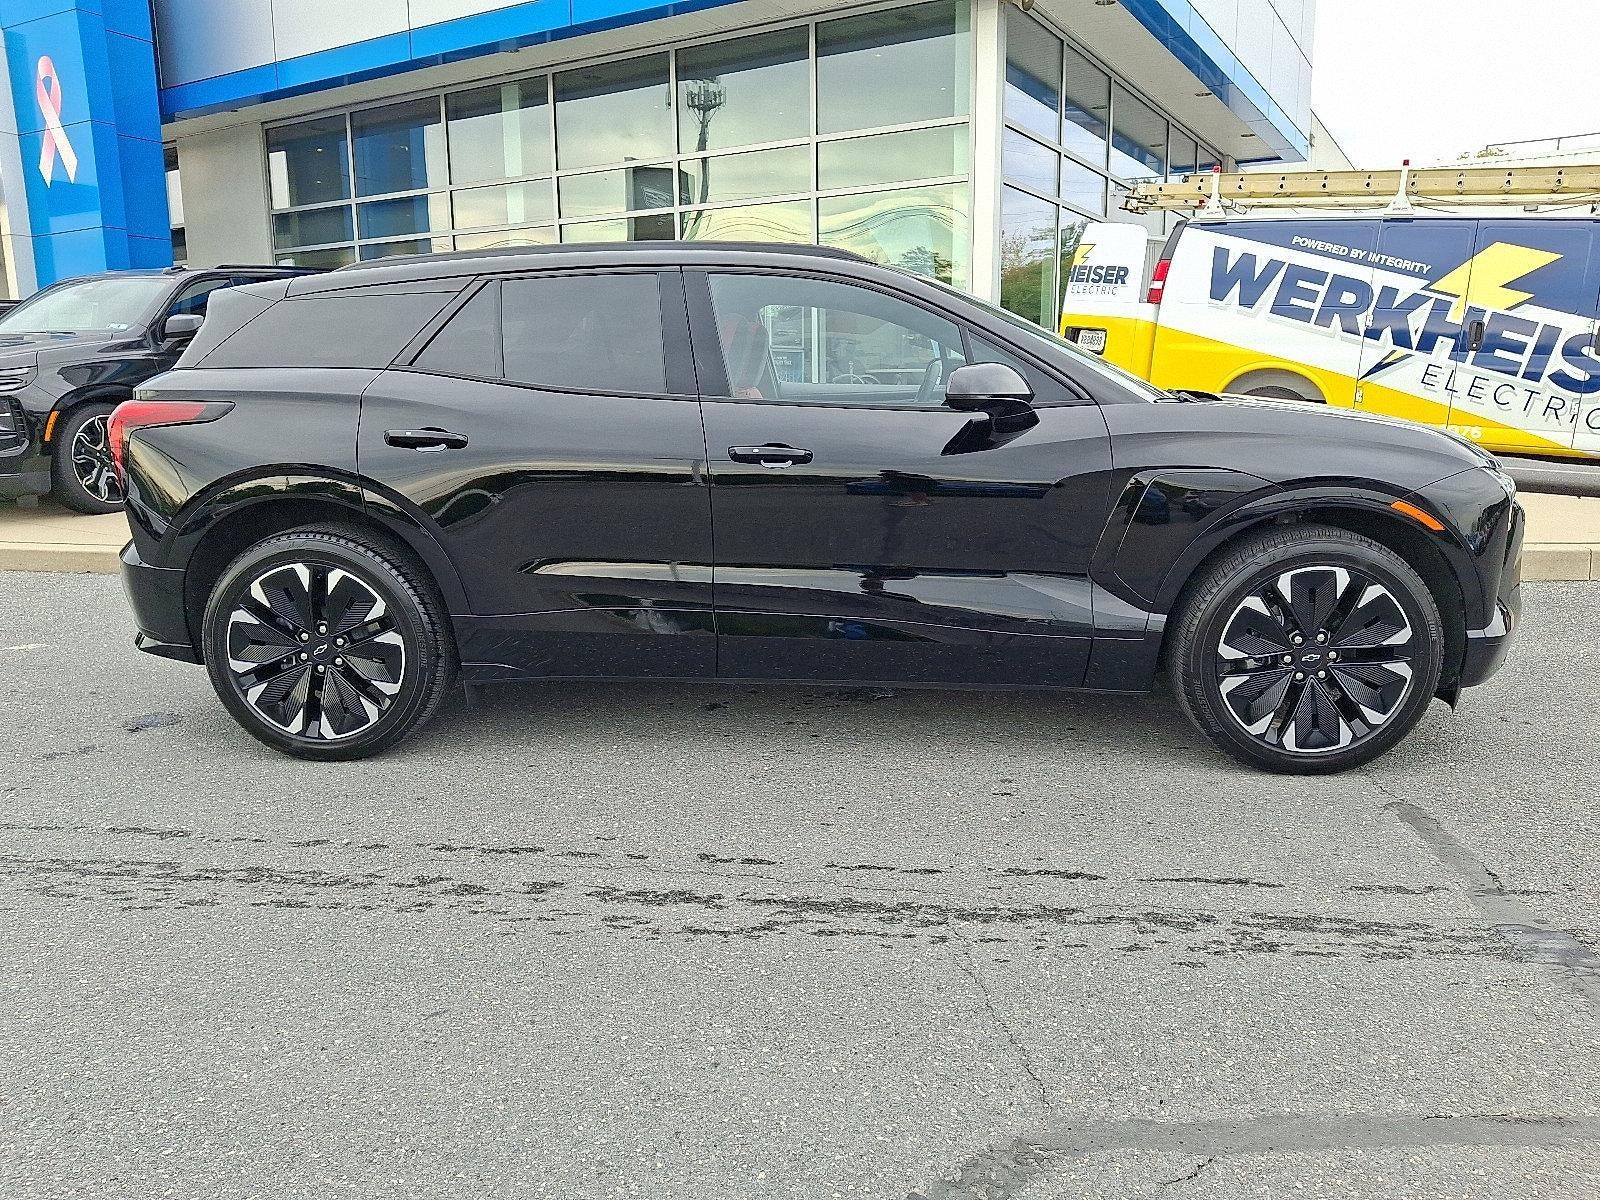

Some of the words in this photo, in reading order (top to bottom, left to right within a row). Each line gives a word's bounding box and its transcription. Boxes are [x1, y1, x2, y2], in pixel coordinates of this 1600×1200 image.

[1291, 235, 1349, 256] POWERED
[1349, 248, 1368, 260] BY
[1367, 253, 1432, 274] INTEGRITY
[1070, 285, 1118, 296] ELECTRIC
